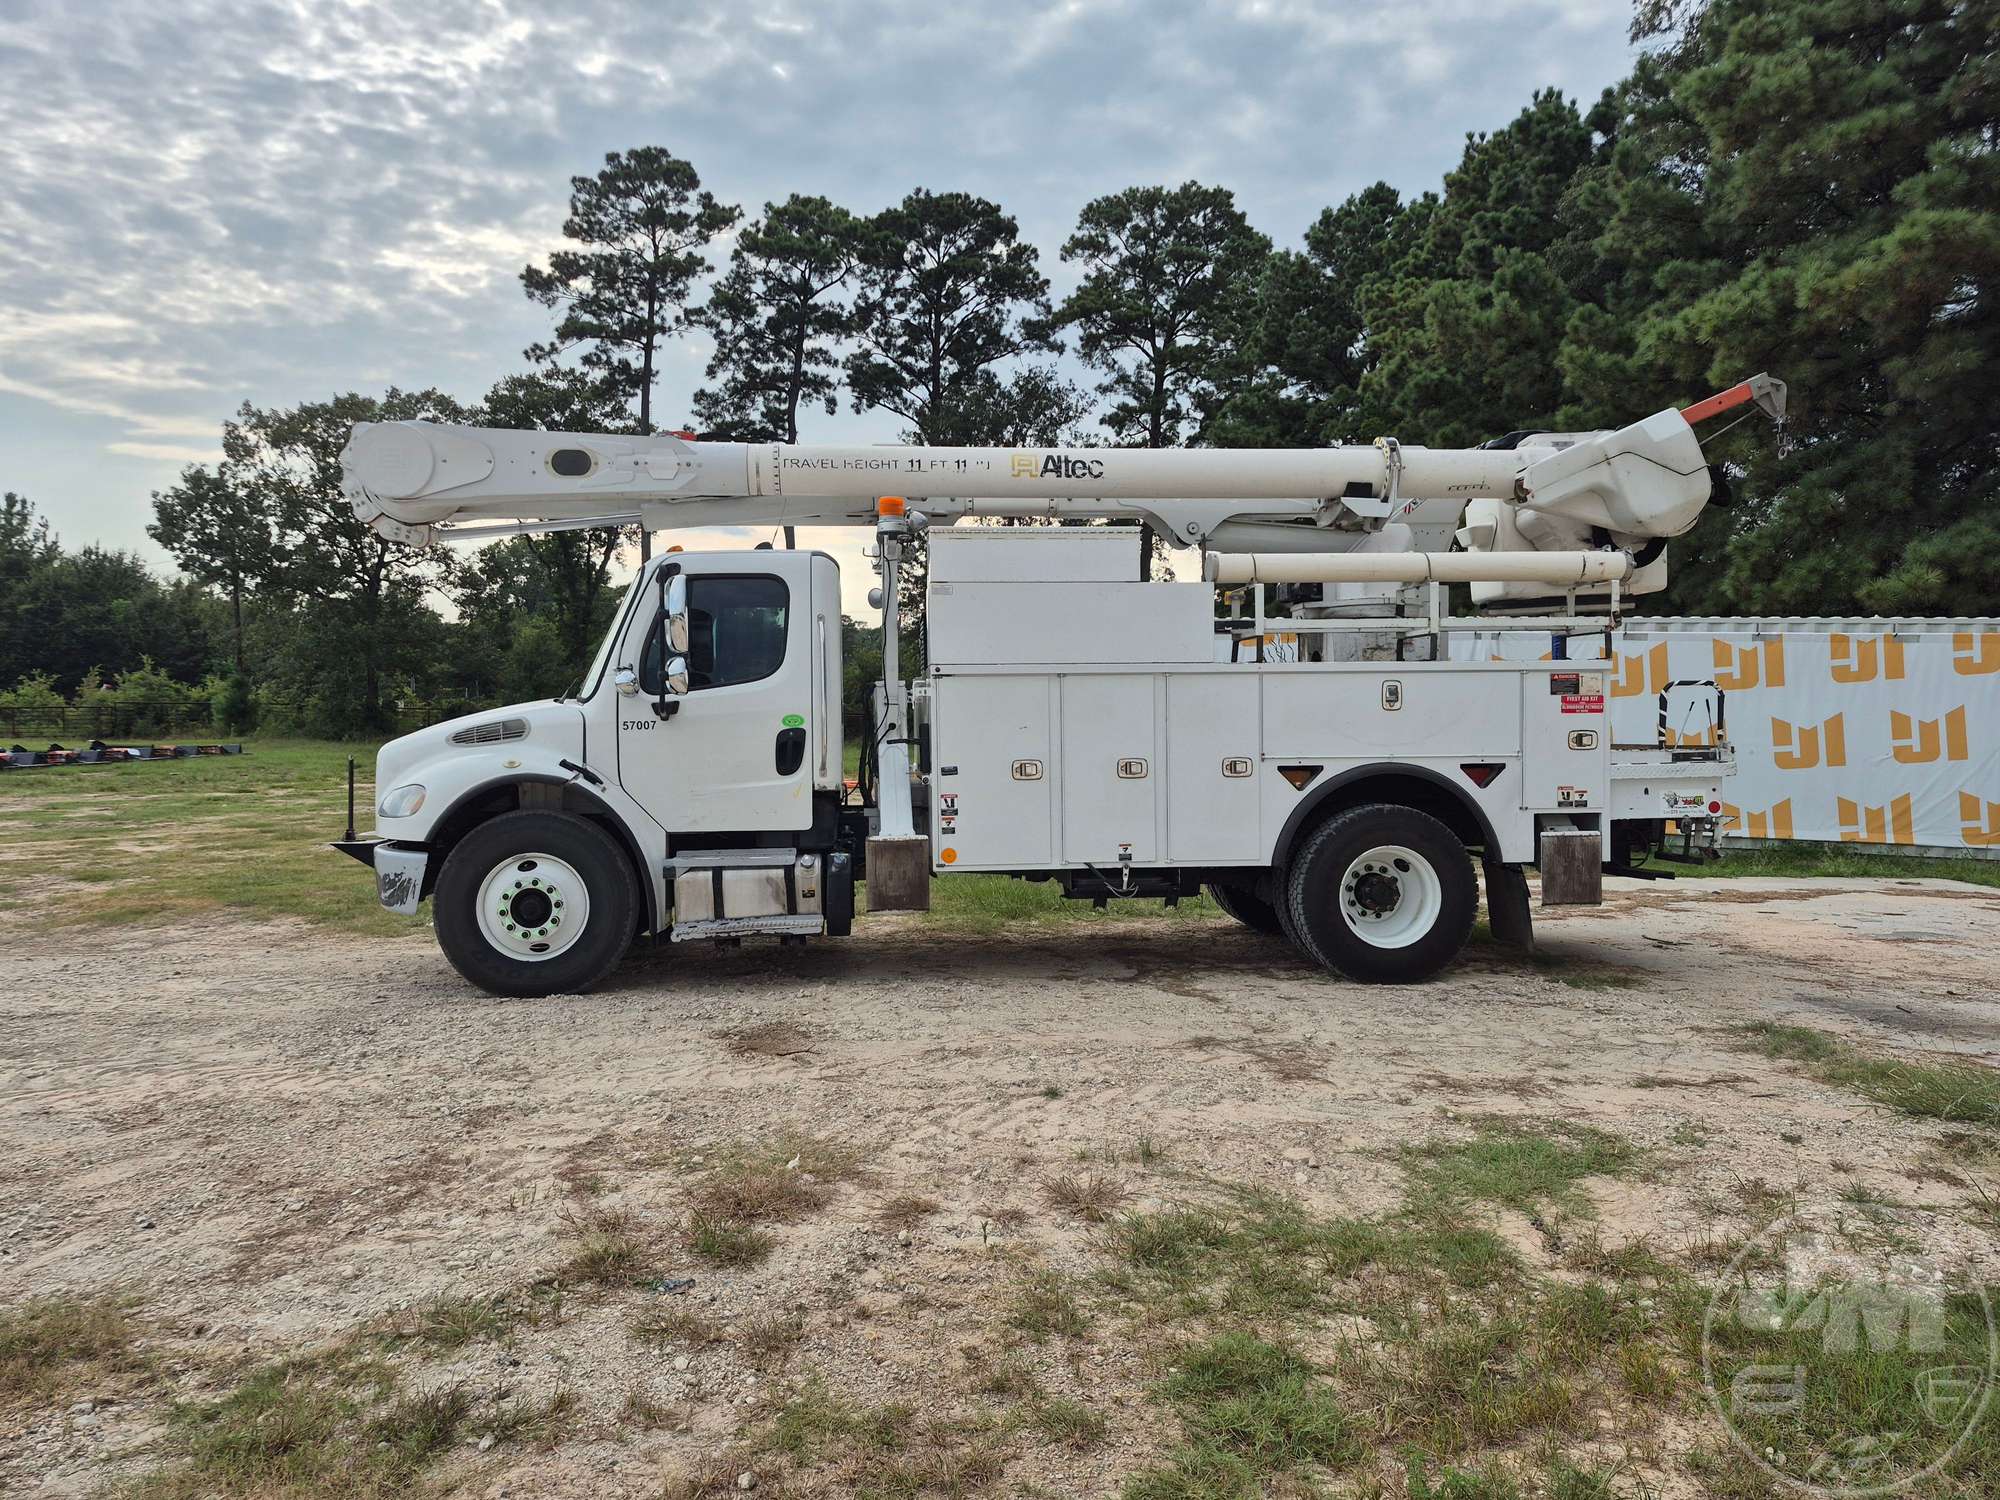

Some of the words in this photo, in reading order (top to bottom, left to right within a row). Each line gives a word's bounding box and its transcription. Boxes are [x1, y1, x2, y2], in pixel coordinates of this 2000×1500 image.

[783, 458, 839, 470] TRAVEL
[843, 459, 900, 470] HEIGHT
[907, 458, 922, 472] 11
[954, 458, 968, 473] 11
[1040, 454, 1105, 479] Altec
[622, 720, 657, 731] 57007
